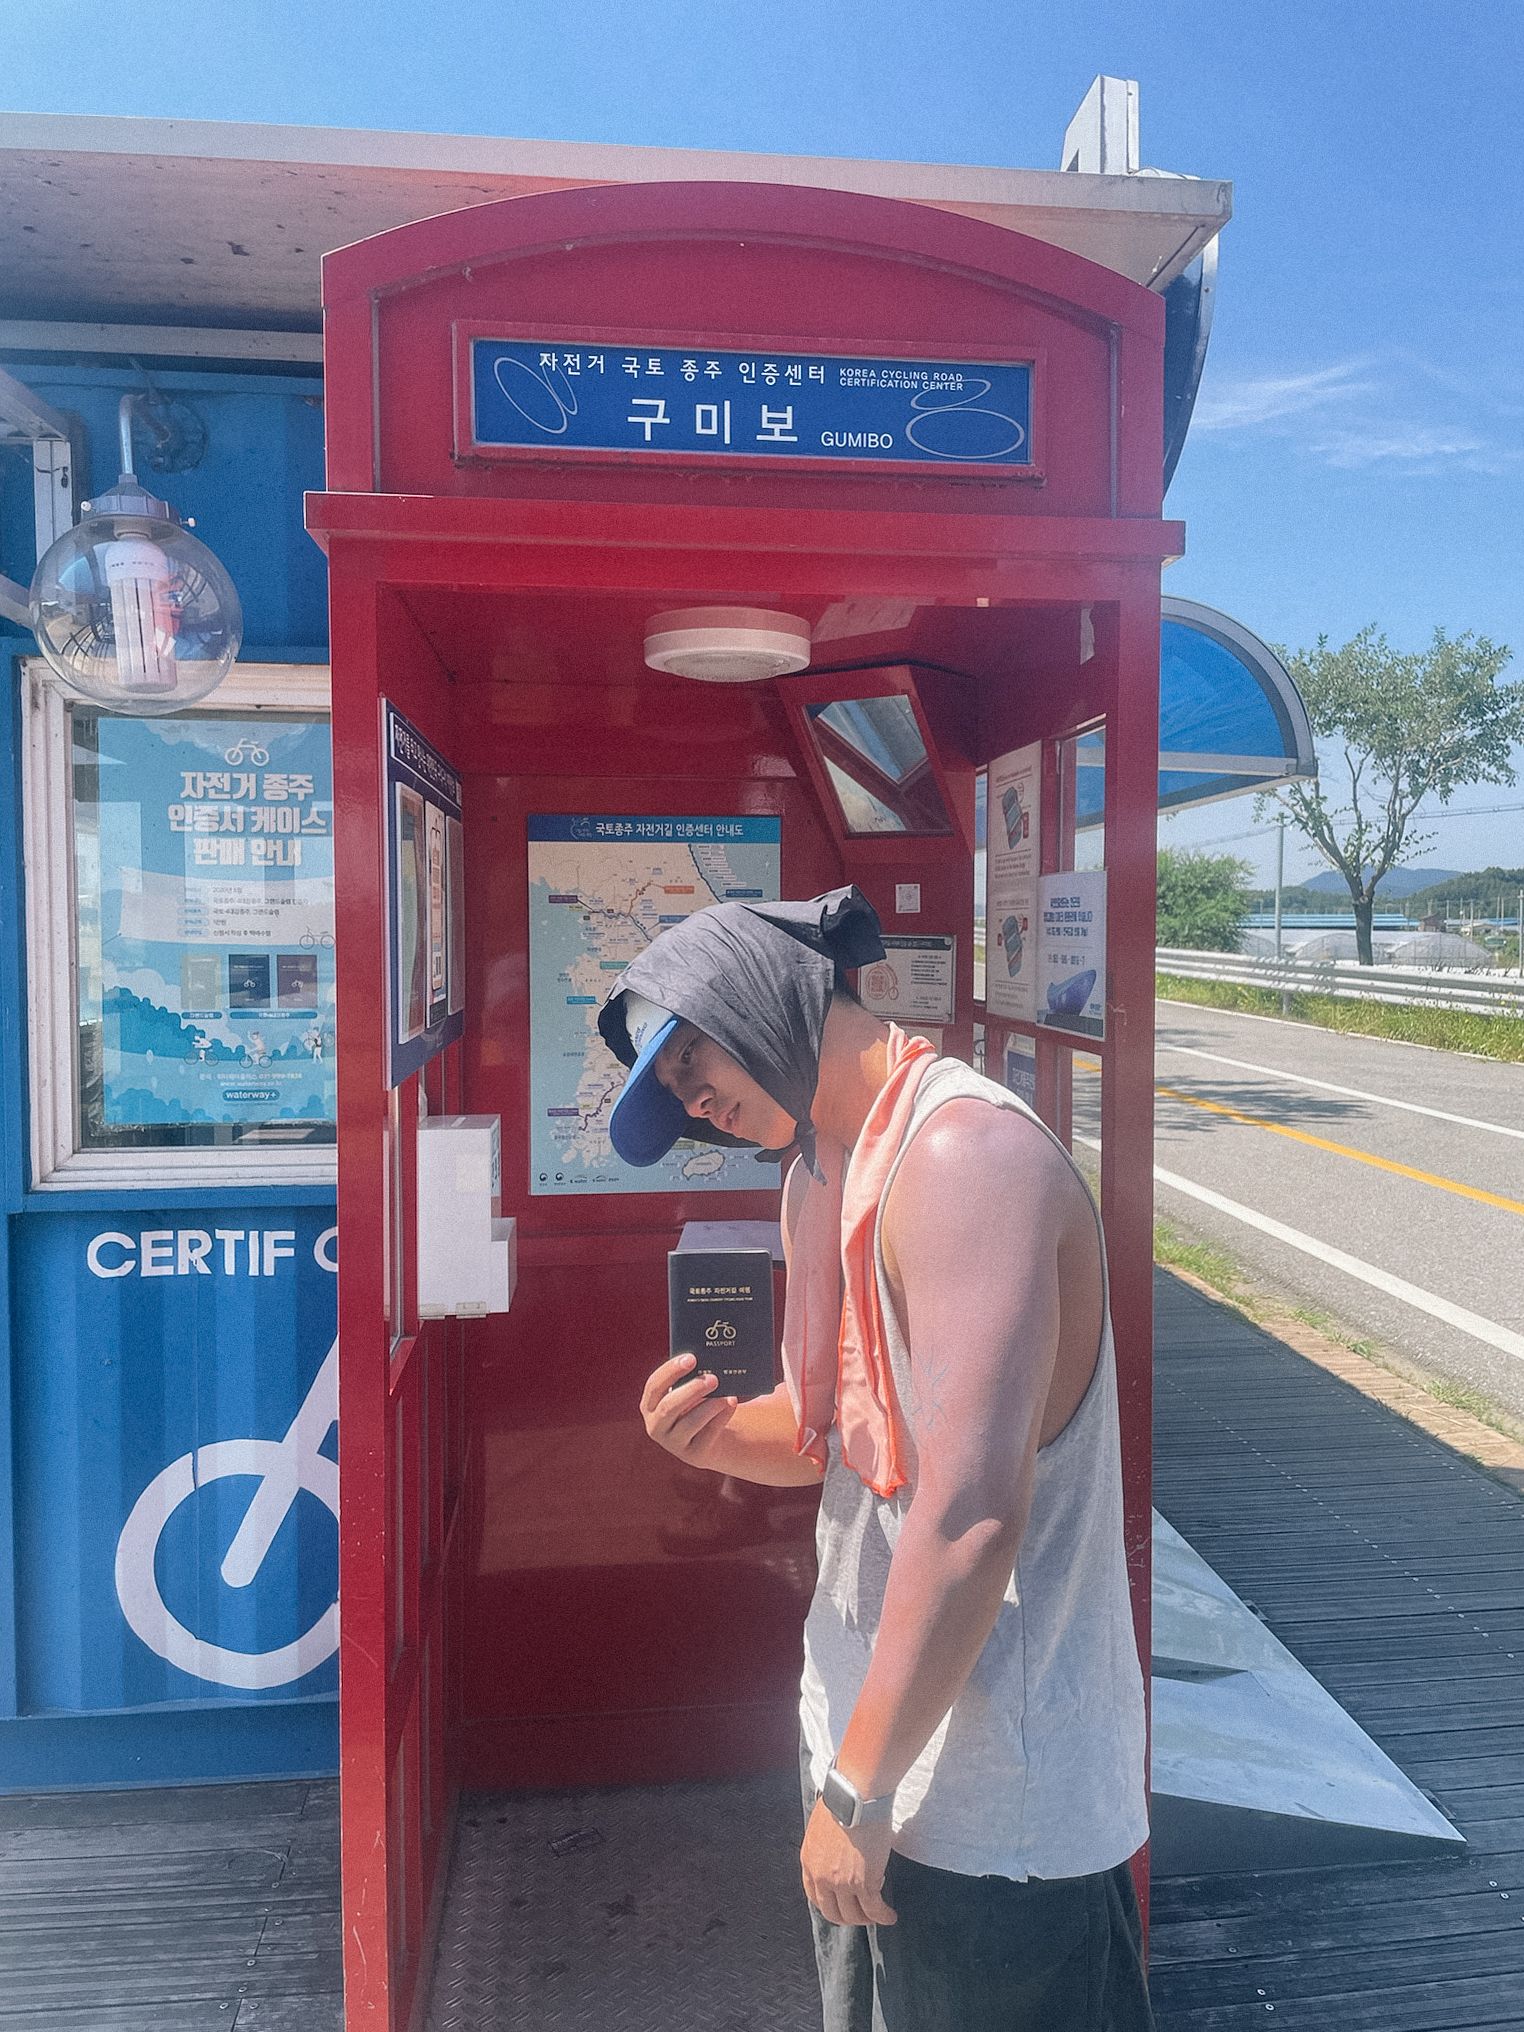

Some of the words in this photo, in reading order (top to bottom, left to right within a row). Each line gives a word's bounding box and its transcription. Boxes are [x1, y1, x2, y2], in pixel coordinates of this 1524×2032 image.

[539, 352, 605, 376] 자전거
[621, 356, 665, 379] 국토
[679, 358, 723, 382] 종주
[738, 361, 826, 386] 인증센터
[839, 367, 877, 379] KOREA
[881, 369, 929, 381] CYCLING
[933, 372, 964, 383] ROAD
[839, 377, 918, 389] CERTIFICATION
[922, 380, 964, 391] CENTER
[820, 431, 894, 449] GUMIBO
[180, 771, 257, 800] 자전거
[263, 773, 315, 801] 종주
[167, 804, 245, 833] 인증서
[251, 806, 327, 835] 케이스
[596, 822, 633, 837] 국토종주
[635, 823, 673, 837] 자전거길
[676, 823, 714, 837] 인증센터
[716, 824, 743, 837] 안내도
[194, 838, 246, 866] 판매
[251, 839, 302, 867] 안내
